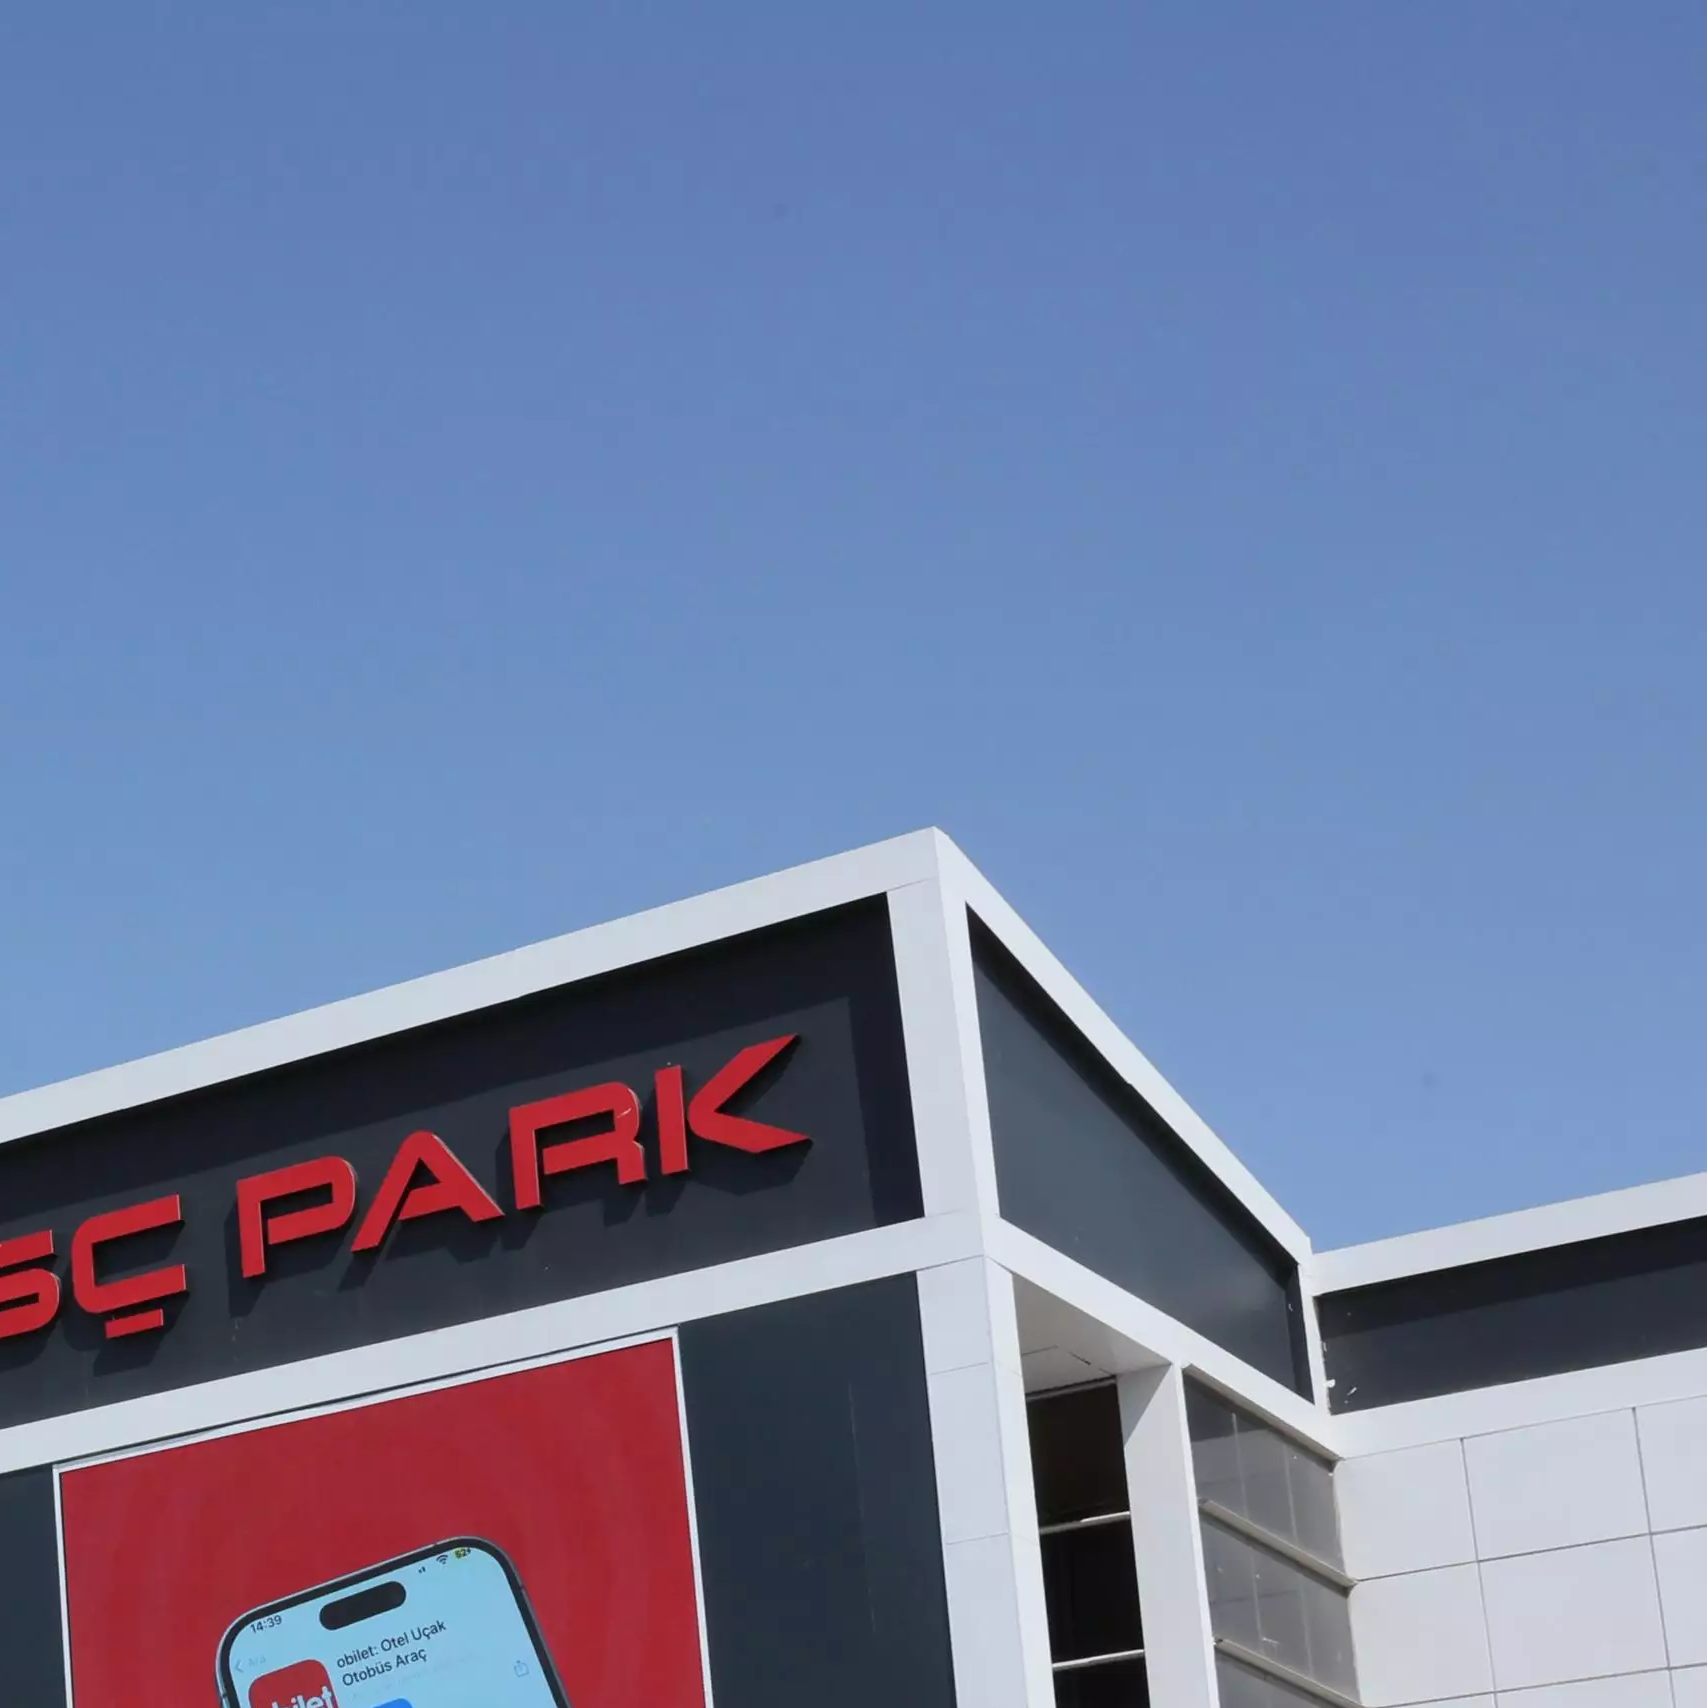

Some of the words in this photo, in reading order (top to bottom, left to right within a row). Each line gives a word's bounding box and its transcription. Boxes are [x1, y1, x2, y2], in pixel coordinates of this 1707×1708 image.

[235, 1033, 812, 1279] PARK
[250, 1614, 283, 1634] 14:39
[336, 1645, 379, 1669] obilet:
[380, 1632, 410, 1652] Otel
[411, 1619, 447, 1641] Uçak
[342, 1659, 393, 1687] Otobüs
[395, 1648, 427, 1668] Araç
